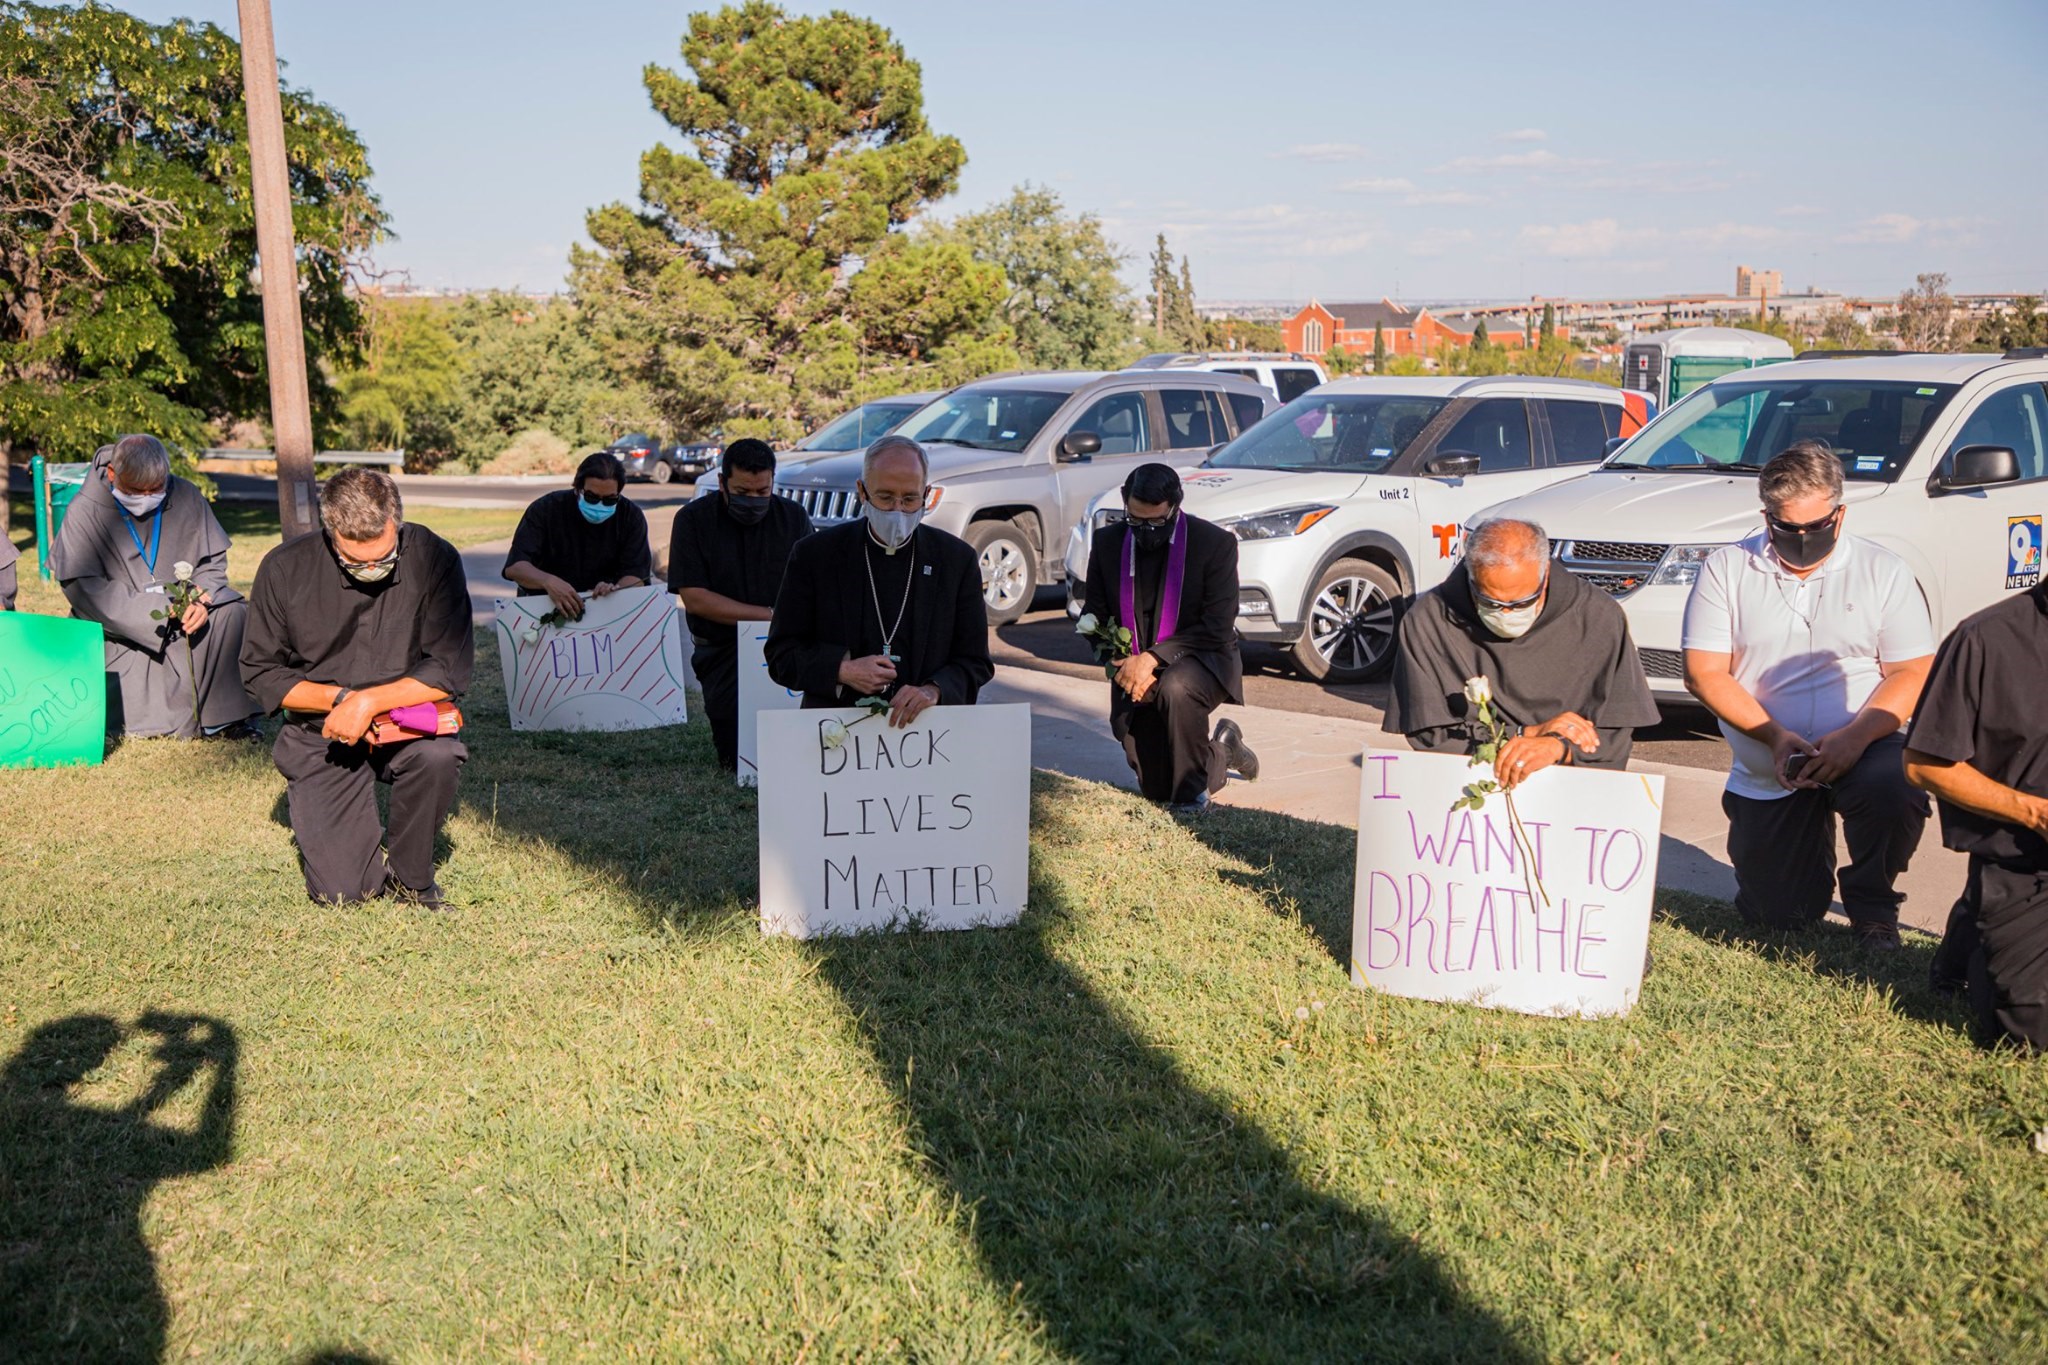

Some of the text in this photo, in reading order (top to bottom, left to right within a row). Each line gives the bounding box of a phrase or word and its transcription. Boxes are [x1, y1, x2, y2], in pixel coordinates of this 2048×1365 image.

[1379, 487, 1409, 500] Unit 2
[2010, 523, 2031, 574] 9
[2024, 564, 2039, 573] KTSM
[2007, 573, 2038, 588] NEWS
[551, 633, 613, 679] BLM
[818, 717, 950, 775] BLACK
[1368, 755, 1401, 799] I
[823, 792, 972, 837] LIVES
[1408, 809, 1648, 892] WANT TO
[824, 855, 998, 910] MATTER
[1368, 870, 1607, 980] BREATHE
